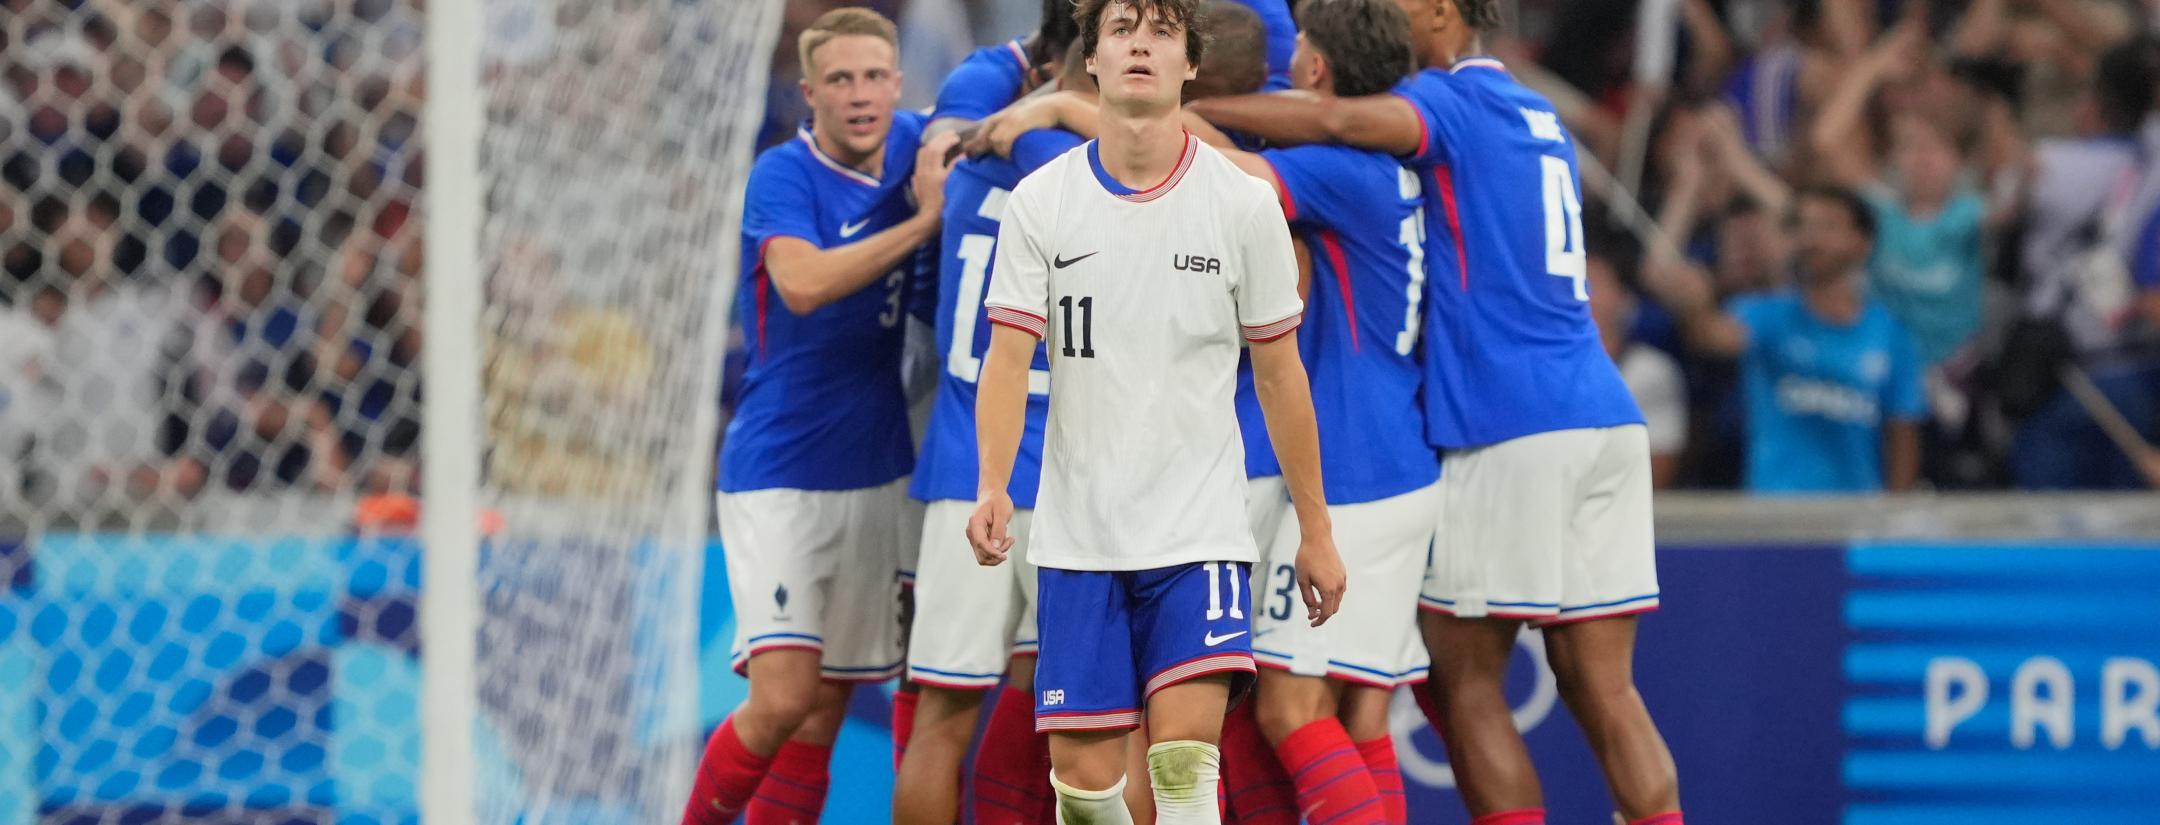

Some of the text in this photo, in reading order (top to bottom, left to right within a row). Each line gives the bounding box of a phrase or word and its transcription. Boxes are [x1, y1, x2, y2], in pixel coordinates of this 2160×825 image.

[1541, 154, 1589, 301] 4
[1173, 253, 1221, 276] USA
[879, 270, 905, 328] 3
[1058, 295, 1095, 359] 11
[1202, 561, 1244, 621] 11
[1043, 689, 1065, 706] USA
[1923, 655, 2160, 751] PAR
